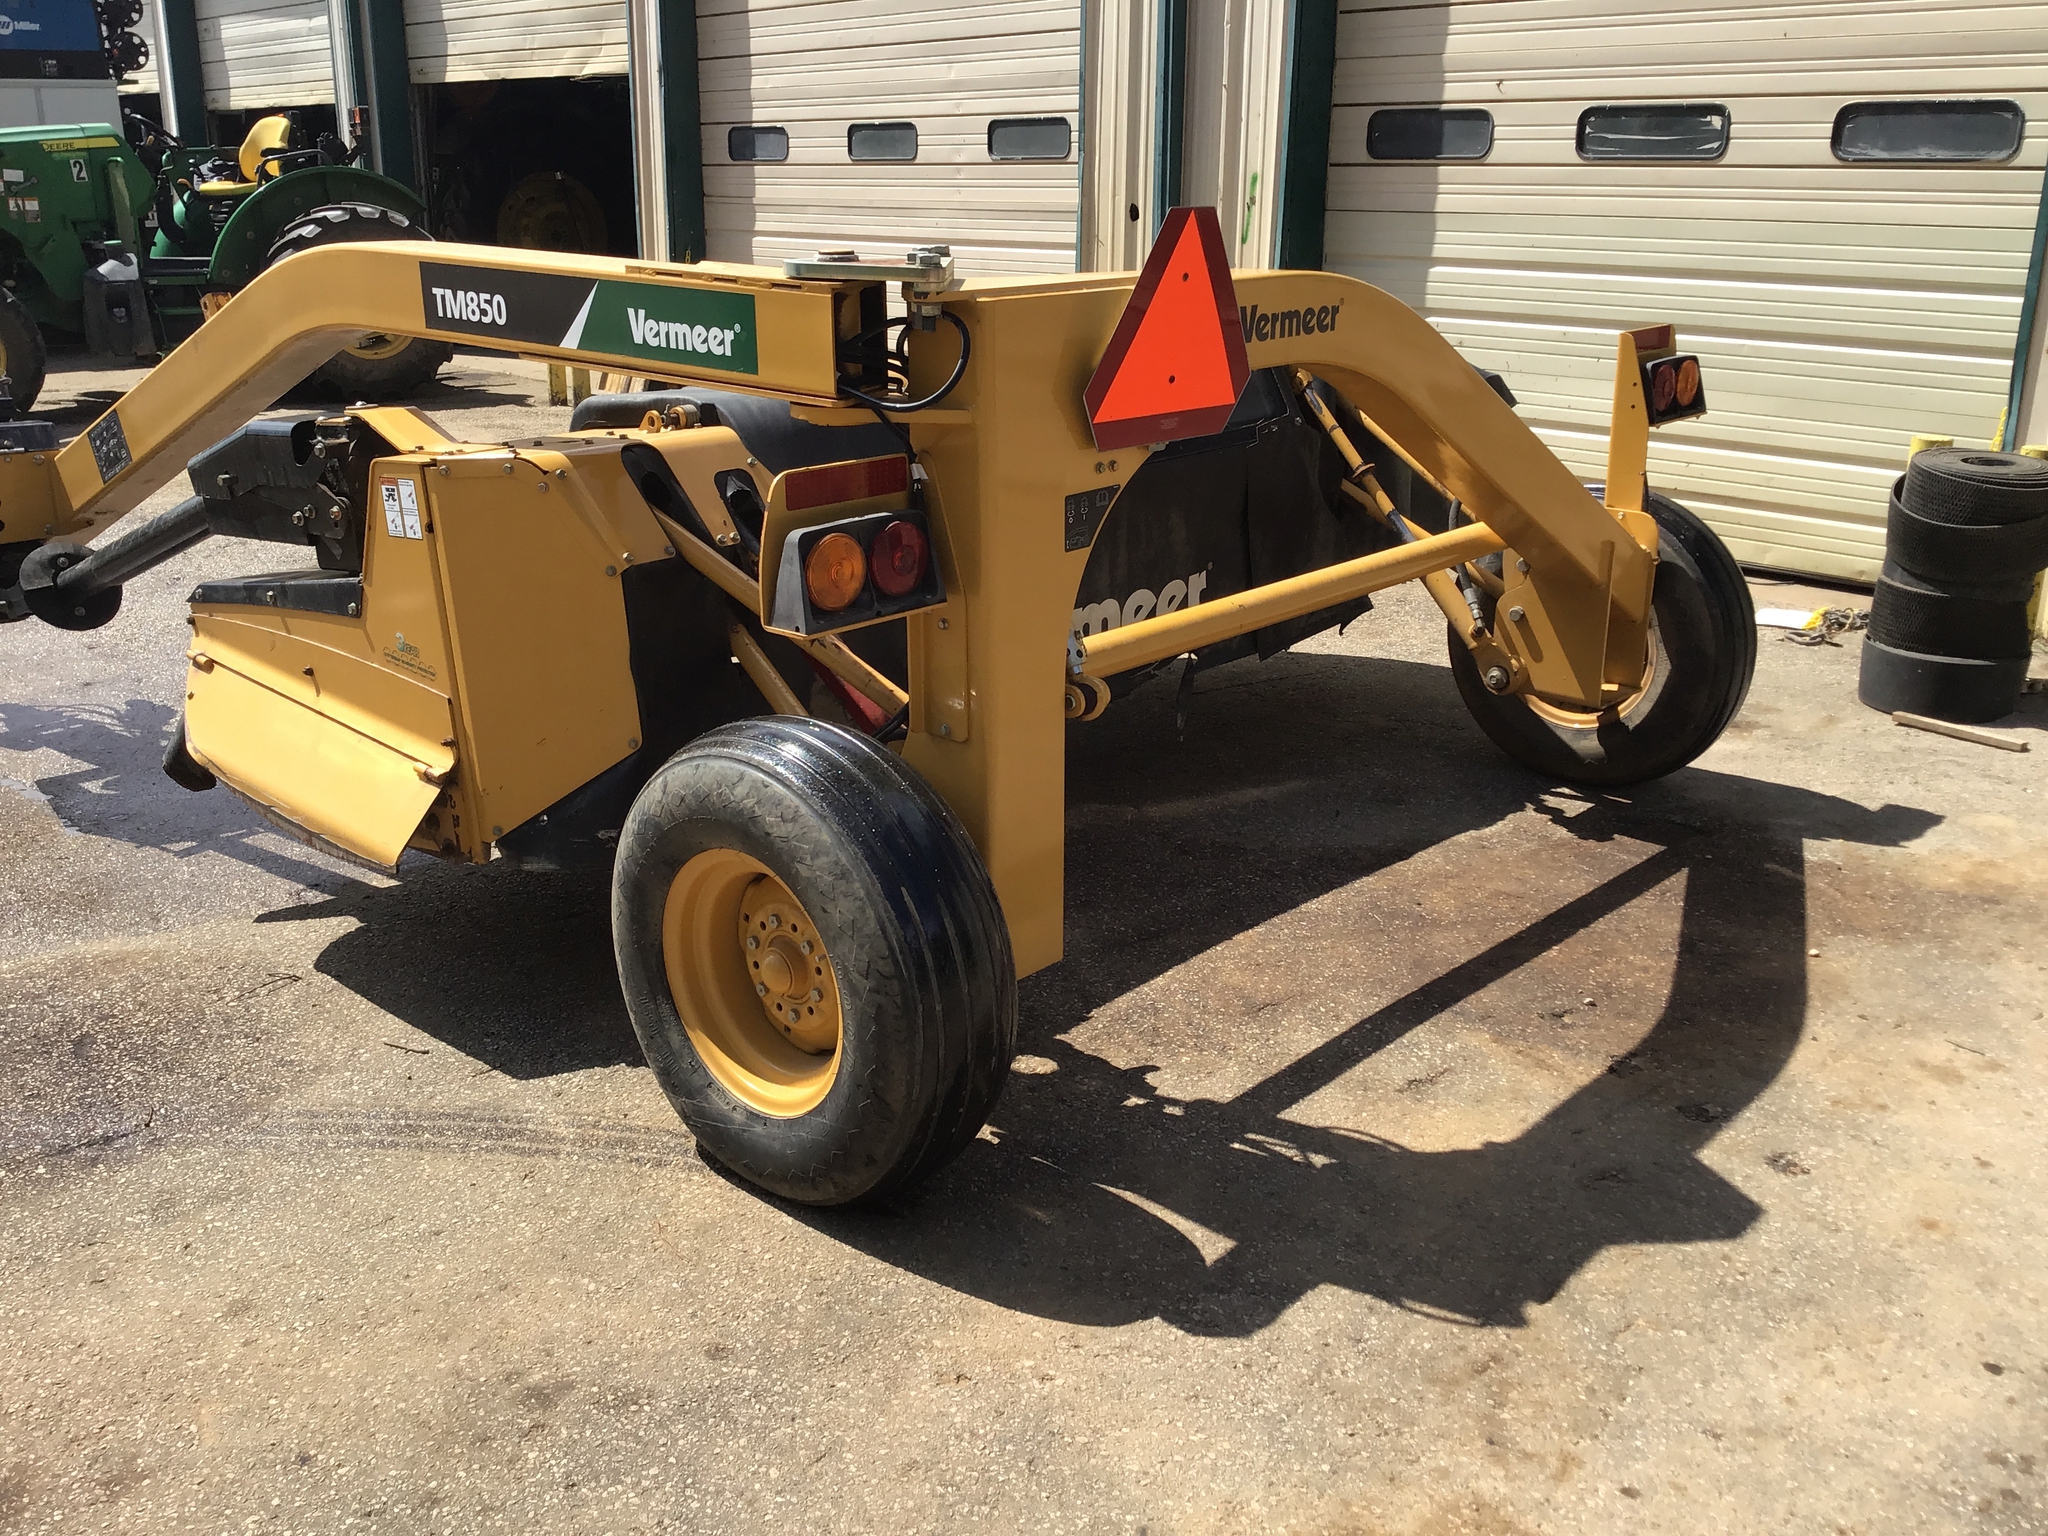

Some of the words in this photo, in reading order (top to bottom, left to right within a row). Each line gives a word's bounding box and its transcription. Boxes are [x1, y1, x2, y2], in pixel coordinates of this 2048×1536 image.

[42, 141, 75, 150] DEERE
[72, 161, 85, 181] 2
[431, 287, 507, 326] TM850
[1240, 304, 1340, 344] Vermeer
[626, 307, 736, 357] Vermeer
